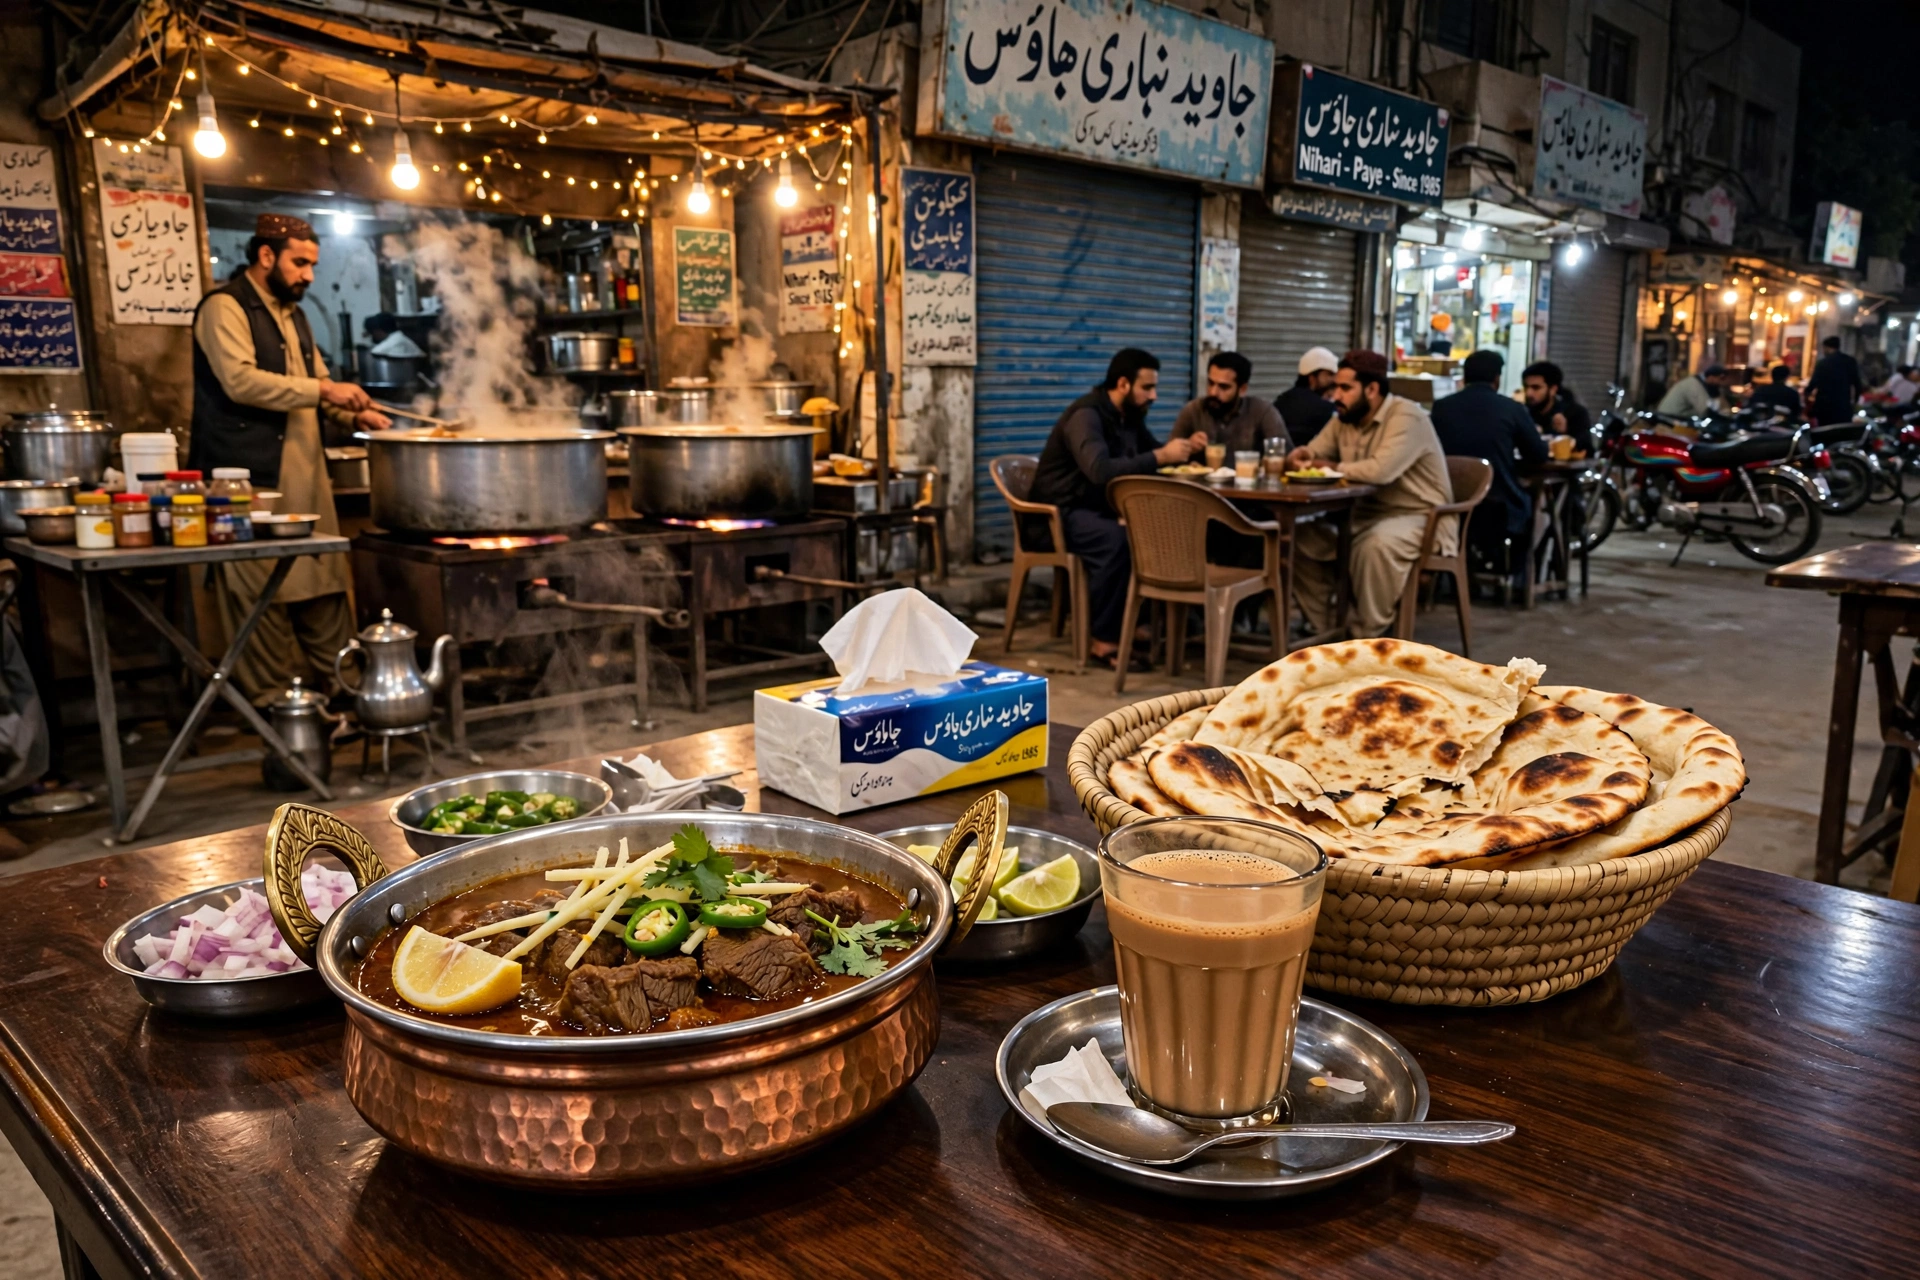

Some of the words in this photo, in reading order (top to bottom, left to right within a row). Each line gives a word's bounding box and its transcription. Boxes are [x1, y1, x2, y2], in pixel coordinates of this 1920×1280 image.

[1082, 31, 1169, 118] نہاری
[1171, 53, 1256, 138] جاوید
[1399, 117, 1440, 168] جاوید
[1299, 143, 1343, 178] Nihari
[1353, 155, 1384, 190] Paye
[1392, 167, 1419, 193] Since
[1420, 173, 1441, 197] 1985
[996, 694, 1035, 728] جاوید
